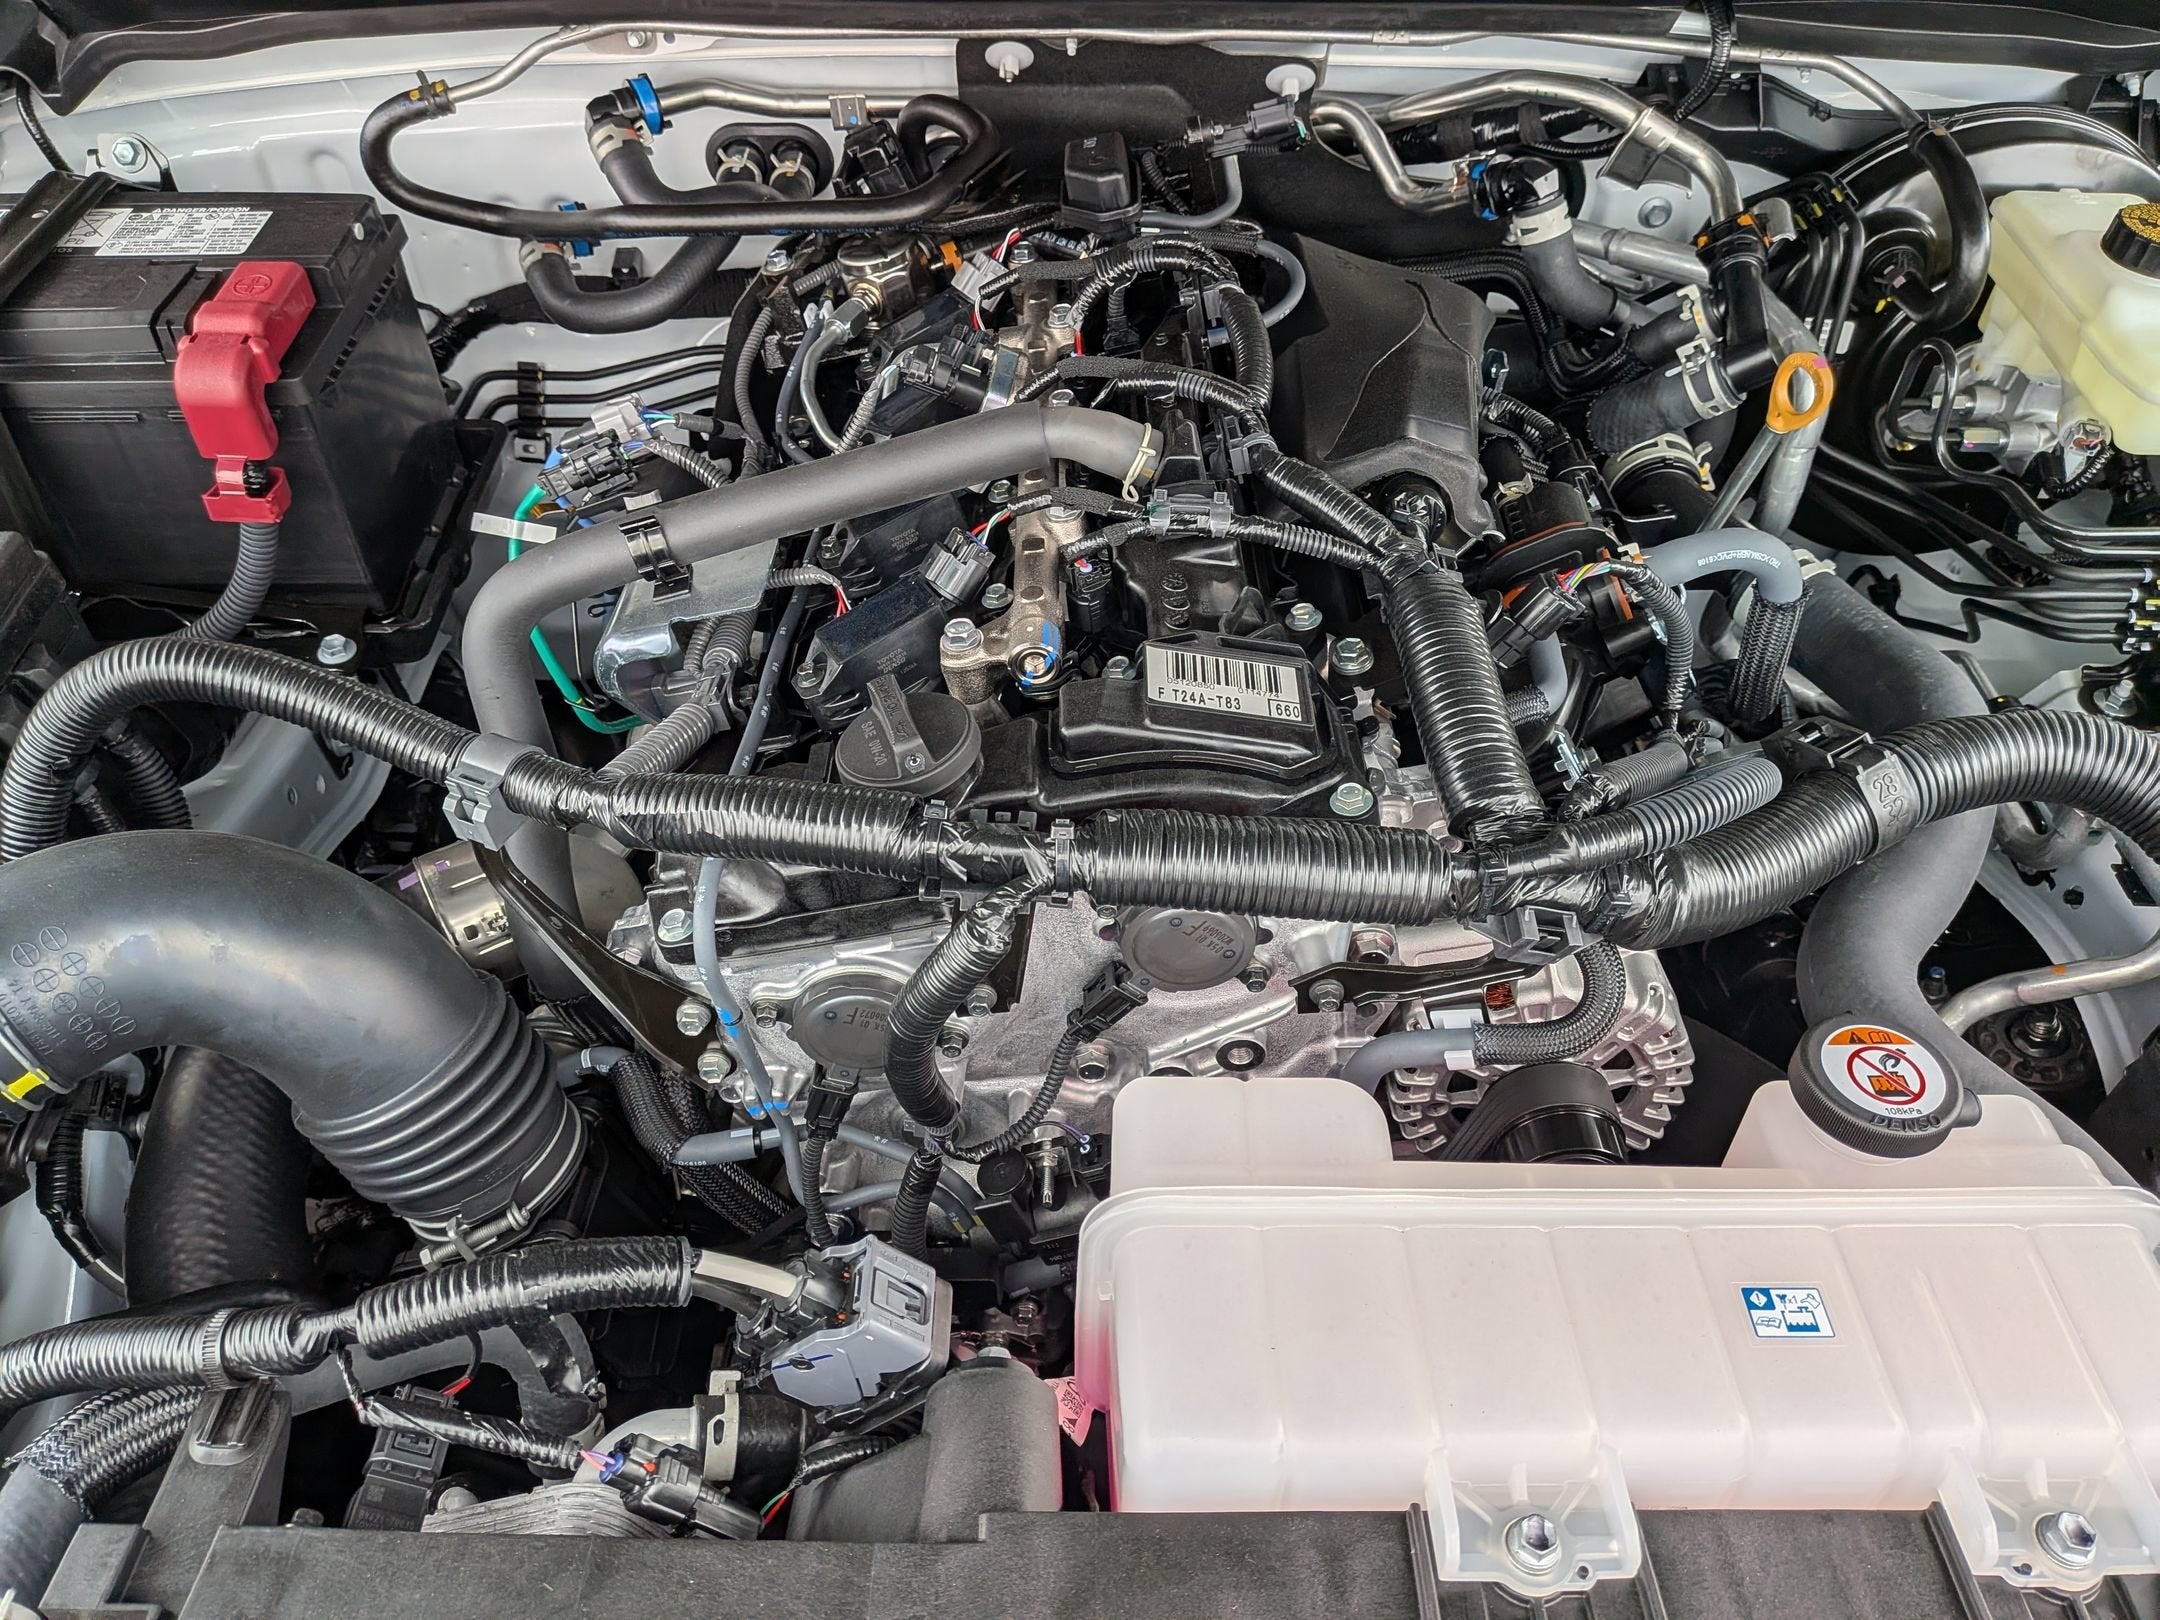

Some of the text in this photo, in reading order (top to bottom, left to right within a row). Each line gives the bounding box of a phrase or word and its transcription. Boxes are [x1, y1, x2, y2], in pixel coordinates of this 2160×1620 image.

[877, 648, 903, 664] TOYOTA
[1172, 688, 1241, 710] T24A-T83
[1275, 703, 1300, 718] 660
[861, 720, 888, 766] SAE 0W-20
[1872, 772, 1898, 804] 28
[1882, 795, 1909, 828] 32
[1869, 1113, 1942, 1132] DENSO
[1884, 1106, 1922, 1116] 108kPa
